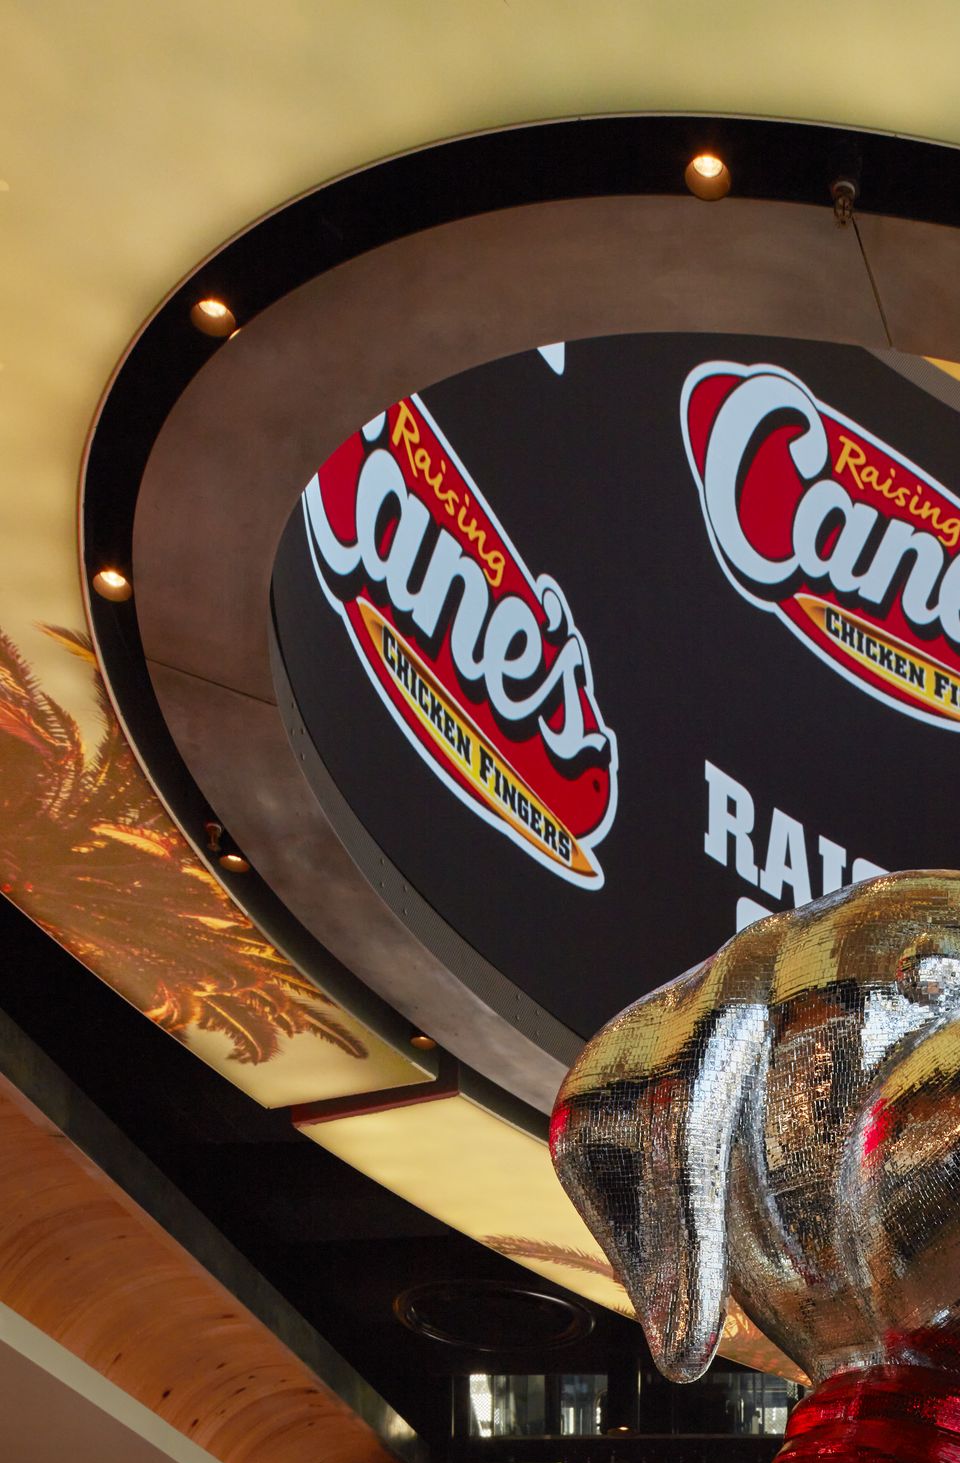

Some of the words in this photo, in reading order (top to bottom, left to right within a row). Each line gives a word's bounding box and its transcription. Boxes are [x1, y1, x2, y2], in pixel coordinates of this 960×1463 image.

[392, 401, 507, 587] Raising
[825, 606, 925, 690] CHICKEN
[382, 625, 472, 766] CHICKEN
[479, 756, 573, 862] FINGERS
[704, 759, 892, 909] RAI
